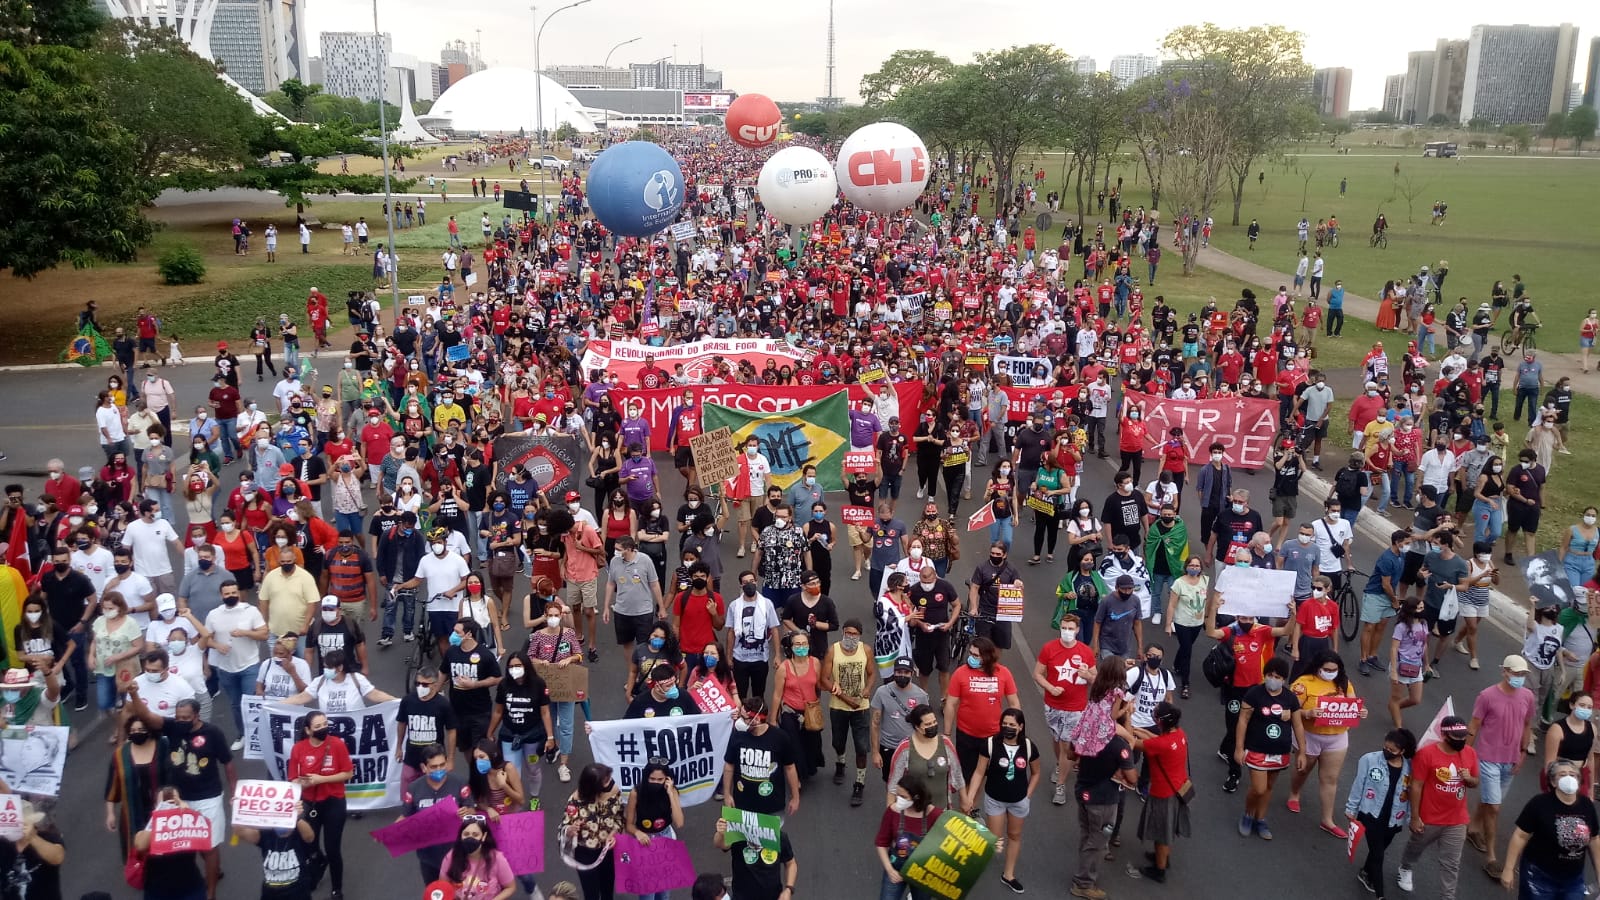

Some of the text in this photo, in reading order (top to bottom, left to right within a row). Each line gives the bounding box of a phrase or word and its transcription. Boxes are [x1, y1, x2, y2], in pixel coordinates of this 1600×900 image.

[794, 169, 812, 180] PRO
[1155, 427, 1271, 466] IVRE
[846, 455, 873, 463] FORA
[843, 508, 873, 516] FORA
[1000, 590, 1023, 598] FORA
[450, 662, 478, 677] FORA
[1061, 667, 1073, 678] PT
[1319, 701, 1359, 712] FORA
[408, 714, 436, 731] FORA
[740, 748, 771, 767] FORA
[241, 784, 277, 799] NÃO
[239, 800, 294, 813] PEC 32
[156, 813, 209, 831] FORA
[155, 829, 209, 842] BOLSONARO
[924, 855, 960, 883] ABAIXO
[907, 862, 962, 900] BOLSONARO
